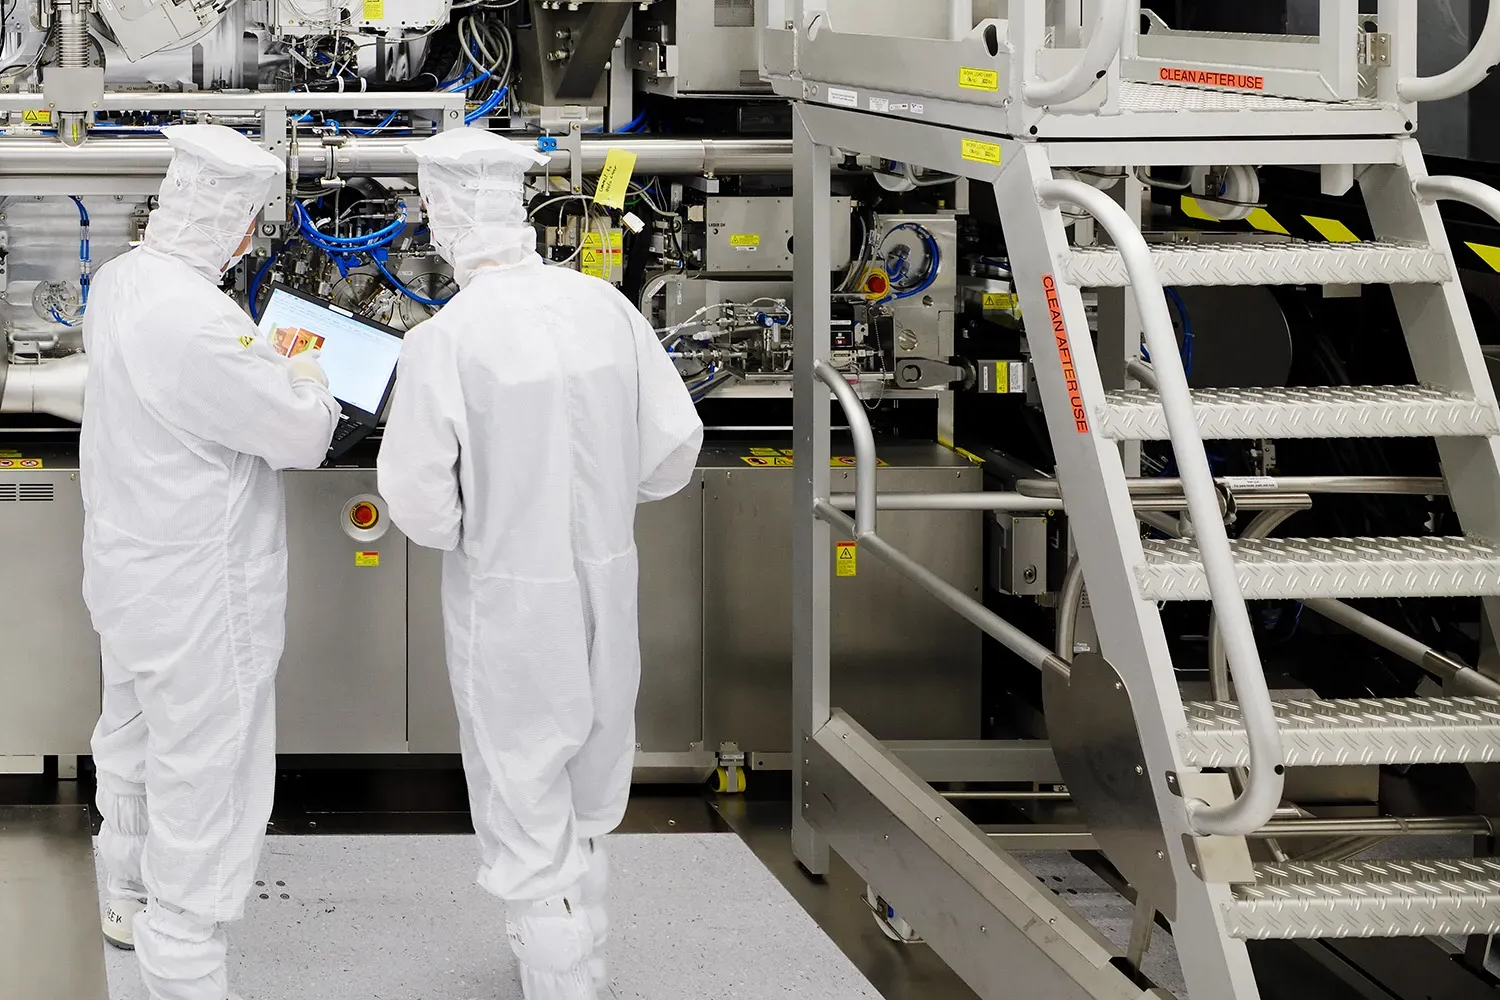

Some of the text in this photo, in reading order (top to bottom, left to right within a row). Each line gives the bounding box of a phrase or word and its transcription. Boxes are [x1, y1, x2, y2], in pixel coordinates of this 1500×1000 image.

[1160, 67, 1263, 90] CLEAN AFTER USE
[1043, 276, 1088, 432] CLEAN AFTER USE
